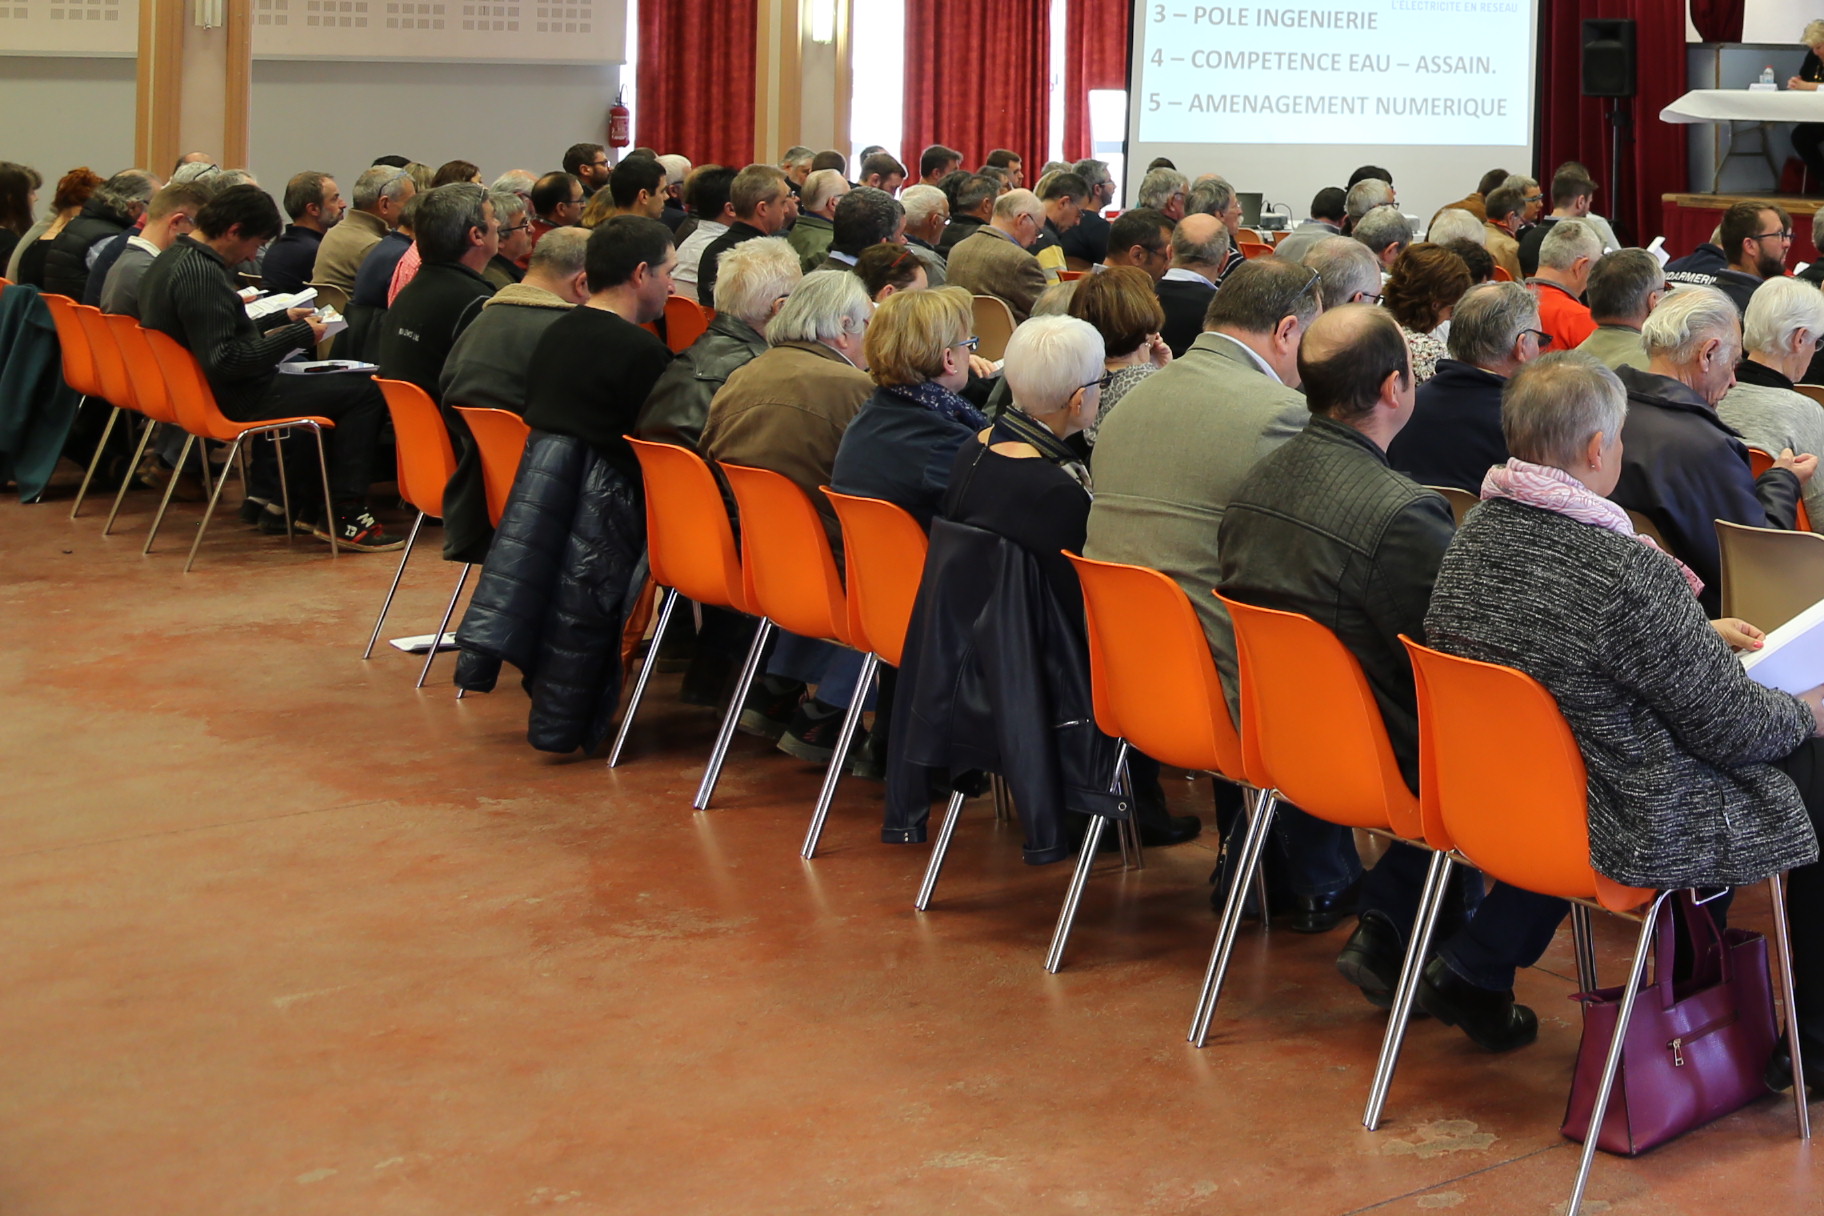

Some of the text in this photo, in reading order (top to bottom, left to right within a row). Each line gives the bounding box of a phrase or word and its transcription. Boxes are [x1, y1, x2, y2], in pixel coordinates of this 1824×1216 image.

[1153, 3, 1166, 24] 3
[1193, 5, 1249, 27] POLE
[1256, 8, 1378, 30] INGENIERIE
[1463, 1, 1477, 13] EN
[1150, 47, 1164, 68] 4
[1191, 49, 1342, 72] COMPETENCE
[1348, 53, 1391, 73] EAU
[1415, 54, 1497, 75] ASSAIN.
[1148, 92, 1161, 112] 5
[1187, 93, 1370, 115] AMENAGEMENT
[1375, 96, 1508, 120] NUMERIQUE
